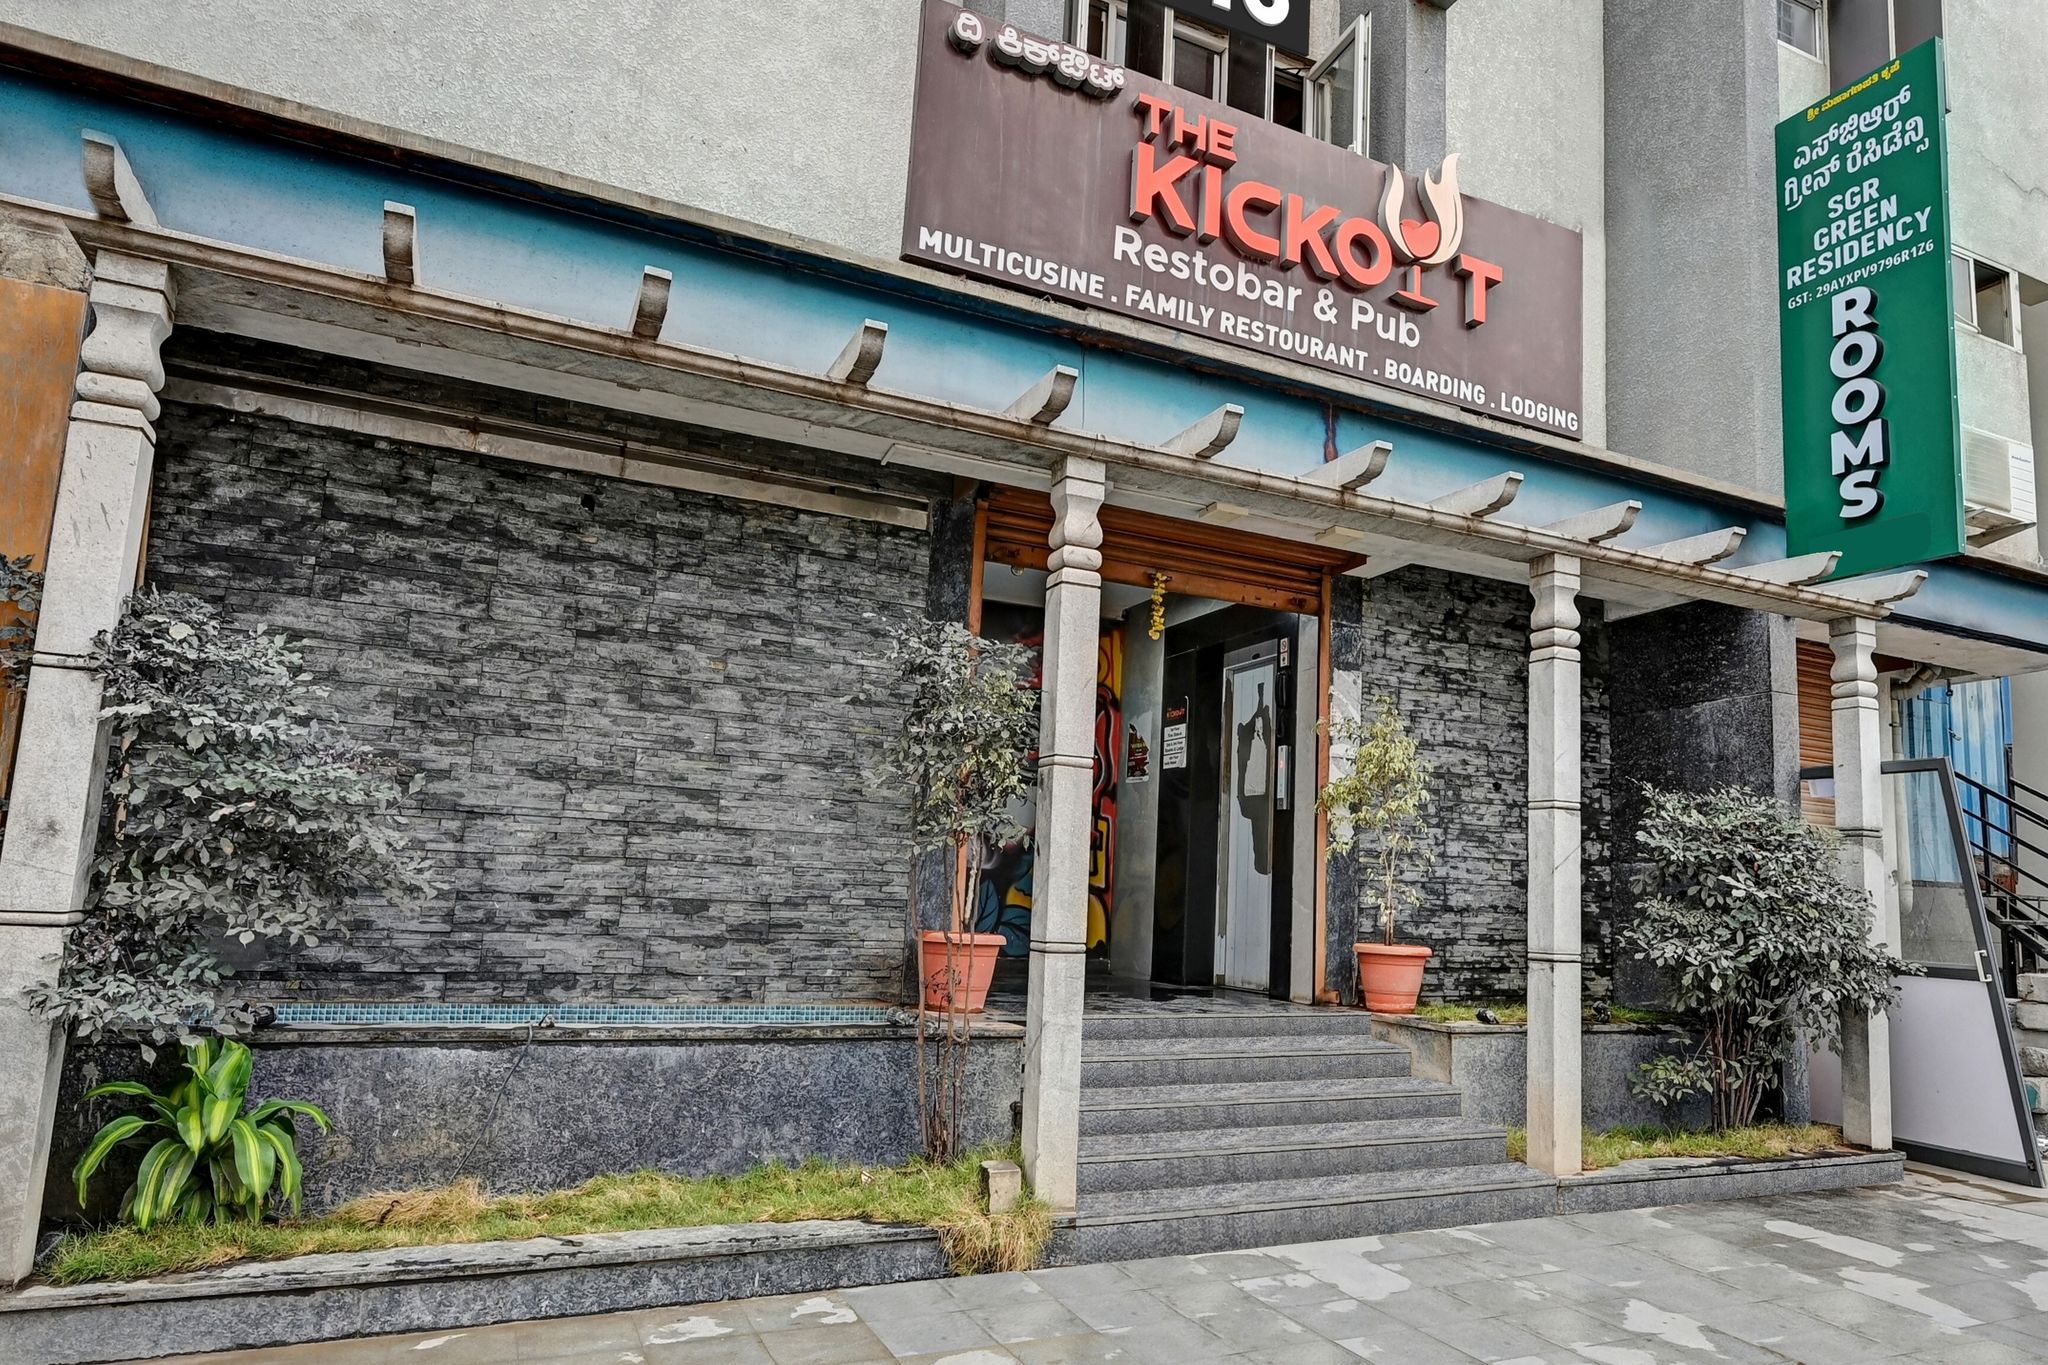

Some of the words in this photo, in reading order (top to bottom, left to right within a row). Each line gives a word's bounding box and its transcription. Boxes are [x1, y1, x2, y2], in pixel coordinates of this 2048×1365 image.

[956, 12, 984, 42] ದಿ
[1135, 92, 1238, 167] THE
[1784, 154, 1840, 211] ಗ್ರೀನ್
[1846, 115, 1929, 174] ರೆಸಿಡೆನ್ಸಿ
[1814, 194, 1898, 251] GREEN
[1828, 177, 1880, 218] SGR
[1113, 225, 1303, 312] Restobar
[1313, 288, 1338, 325] &
[1351, 298, 1420, 348] Pub
[1786, 206, 1932, 290] RESIDENCY
[1787, 291, 1813, 310] GST:
[1815, 239, 1934, 298] 29AYXPV9796R1Z6
[918, 226, 1105, 299] MULTICUSINE
[1125, 284, 1215, 328] FAMILY
[1219, 310, 1368, 372] RESTOURANT
[1384, 358, 1486, 404] BOARDING
[1500, 391, 1579, 432] LODGING
[1830, 286, 1887, 518] ROOMS
